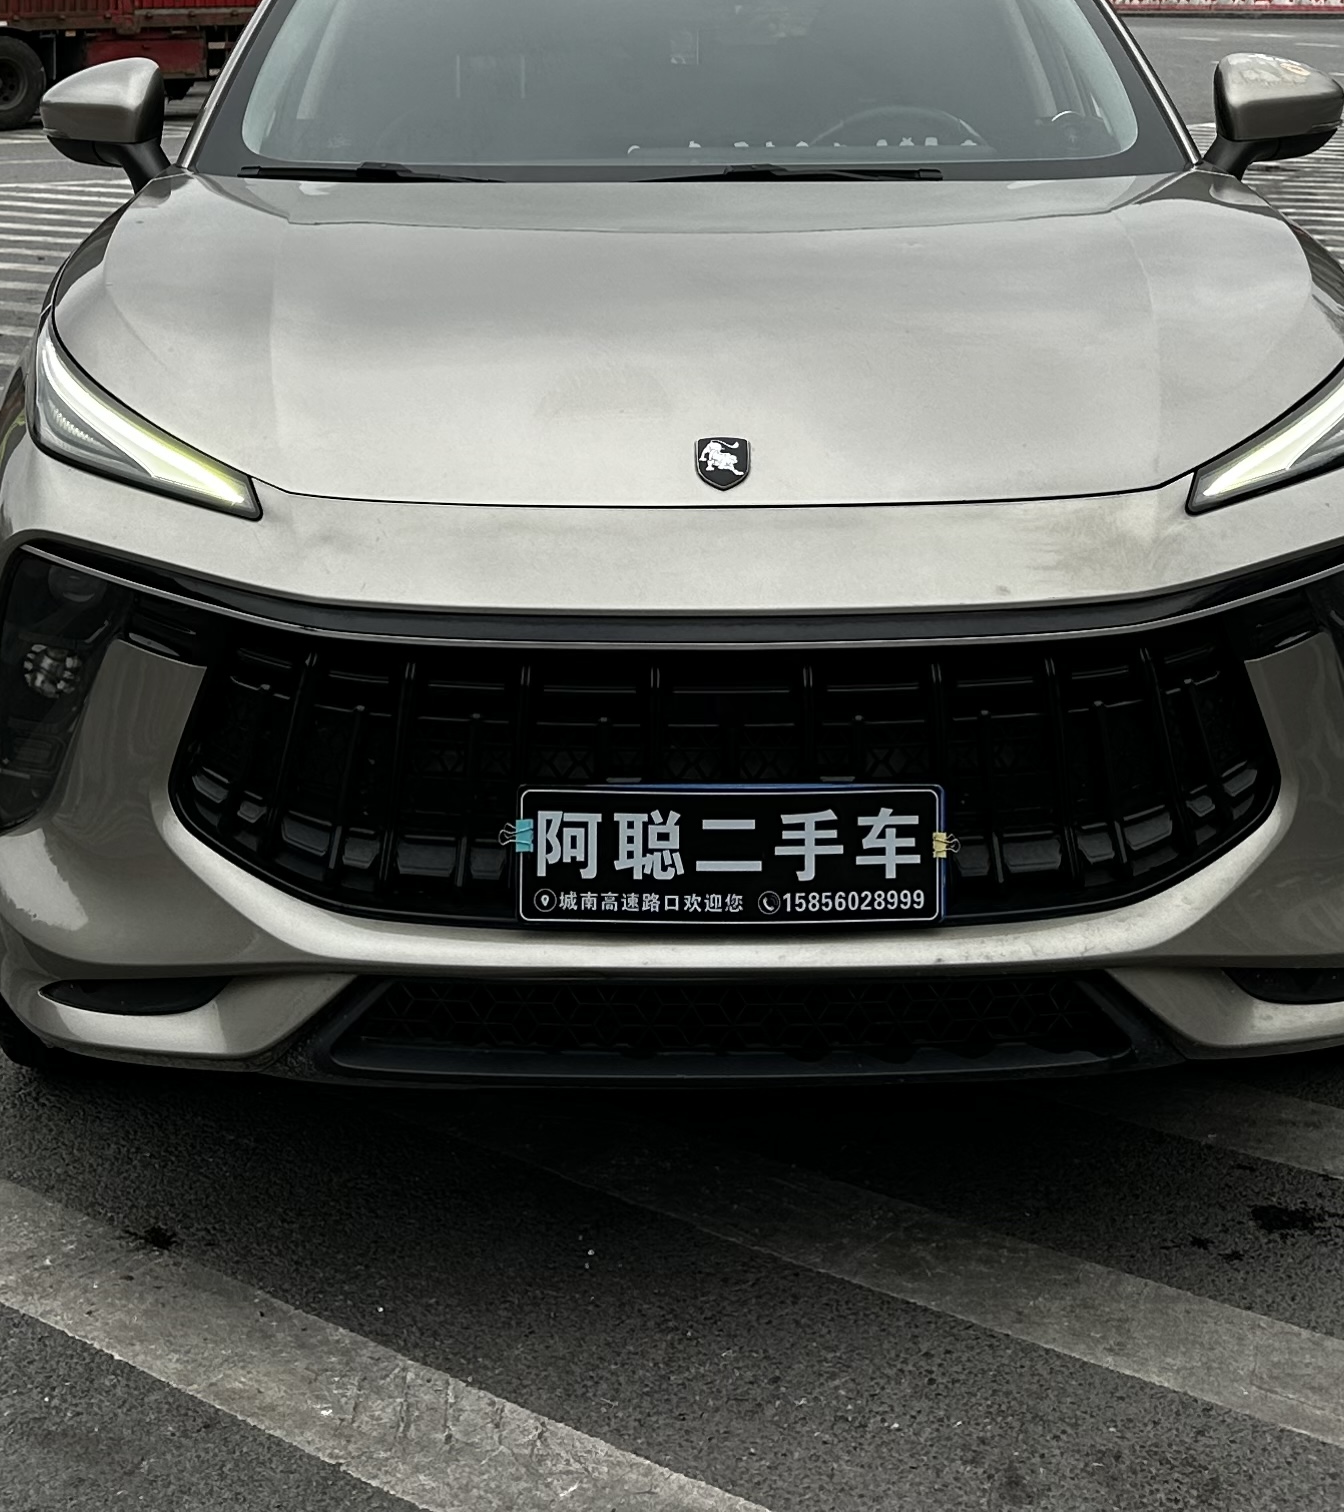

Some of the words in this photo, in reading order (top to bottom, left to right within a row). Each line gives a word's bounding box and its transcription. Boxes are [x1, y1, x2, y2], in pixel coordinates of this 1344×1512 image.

[536, 808, 922, 881] 阿聪二手车
[558, 891, 744, 913] 城南高速路口欢迎您
[782, 890, 926, 913] 15856028999
